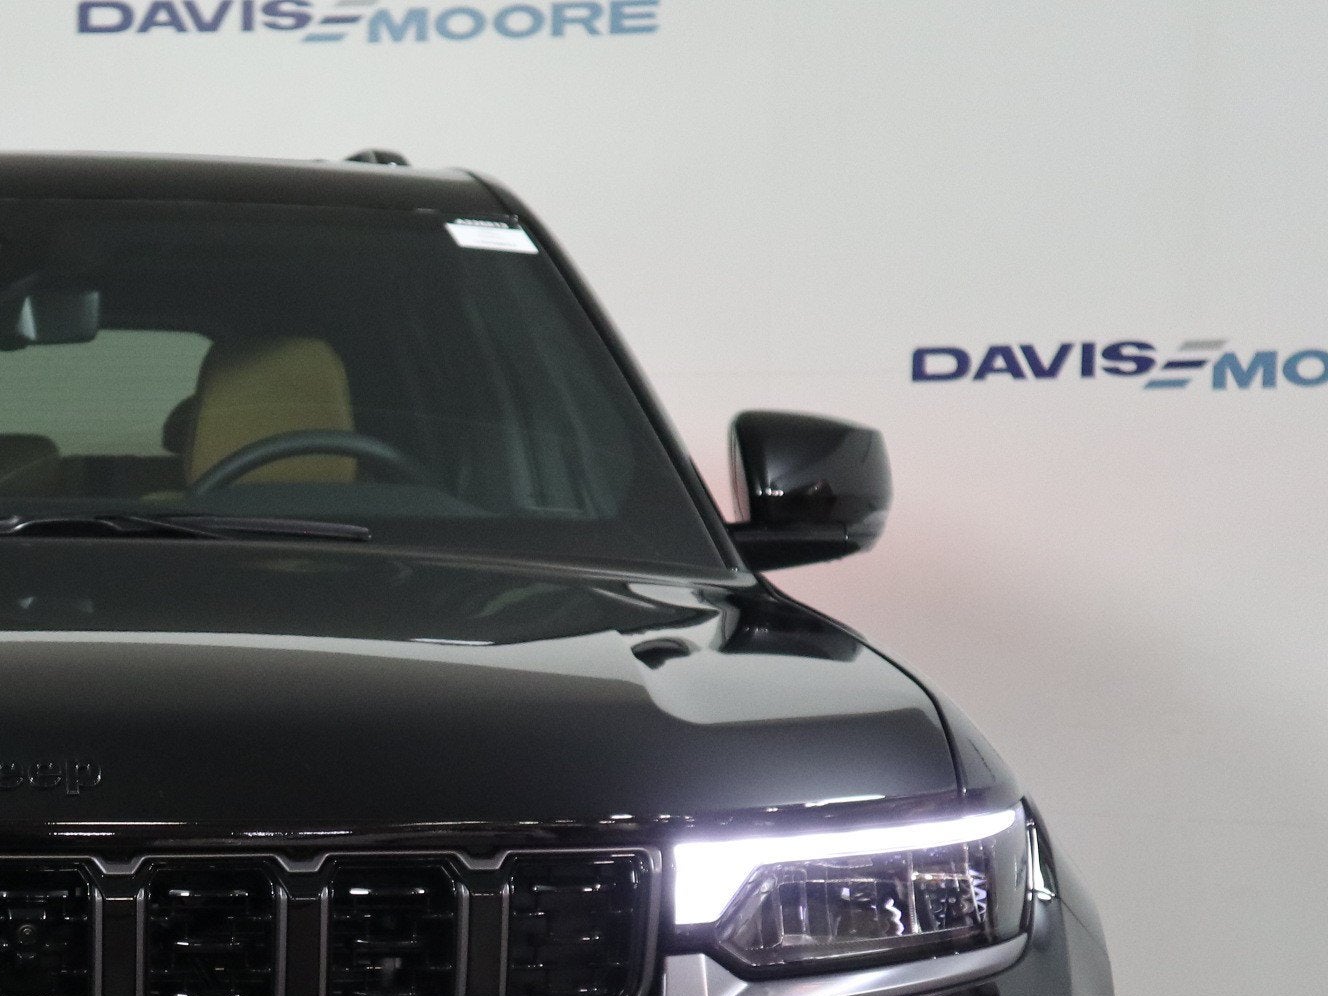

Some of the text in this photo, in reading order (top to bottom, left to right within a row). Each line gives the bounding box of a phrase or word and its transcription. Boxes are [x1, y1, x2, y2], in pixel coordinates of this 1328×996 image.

[77, 0, 660, 43] DAVIS MOORE
[911, 340, 1156, 382] DAVIS
